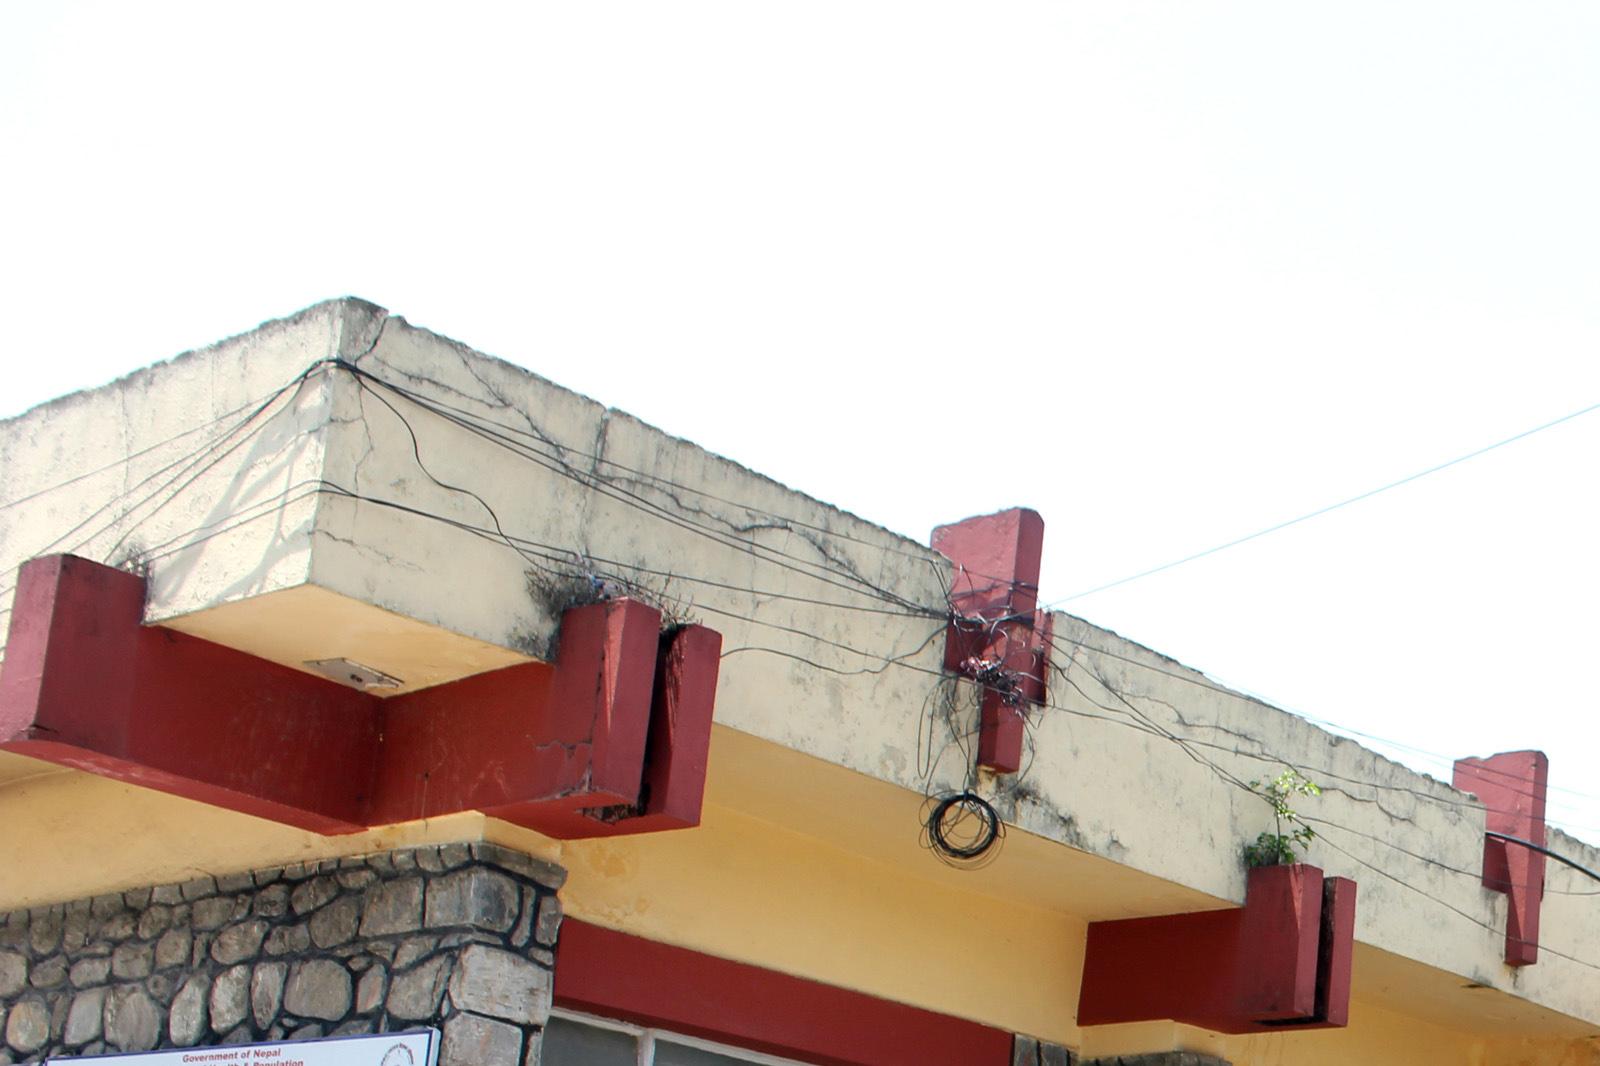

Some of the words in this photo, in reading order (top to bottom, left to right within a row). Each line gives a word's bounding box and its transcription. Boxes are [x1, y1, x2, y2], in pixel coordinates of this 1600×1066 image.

[182, 1051, 238, 1063] Government
[240, 1050, 251, 1060] of
[253, 1048, 281, 1059] Nepal
